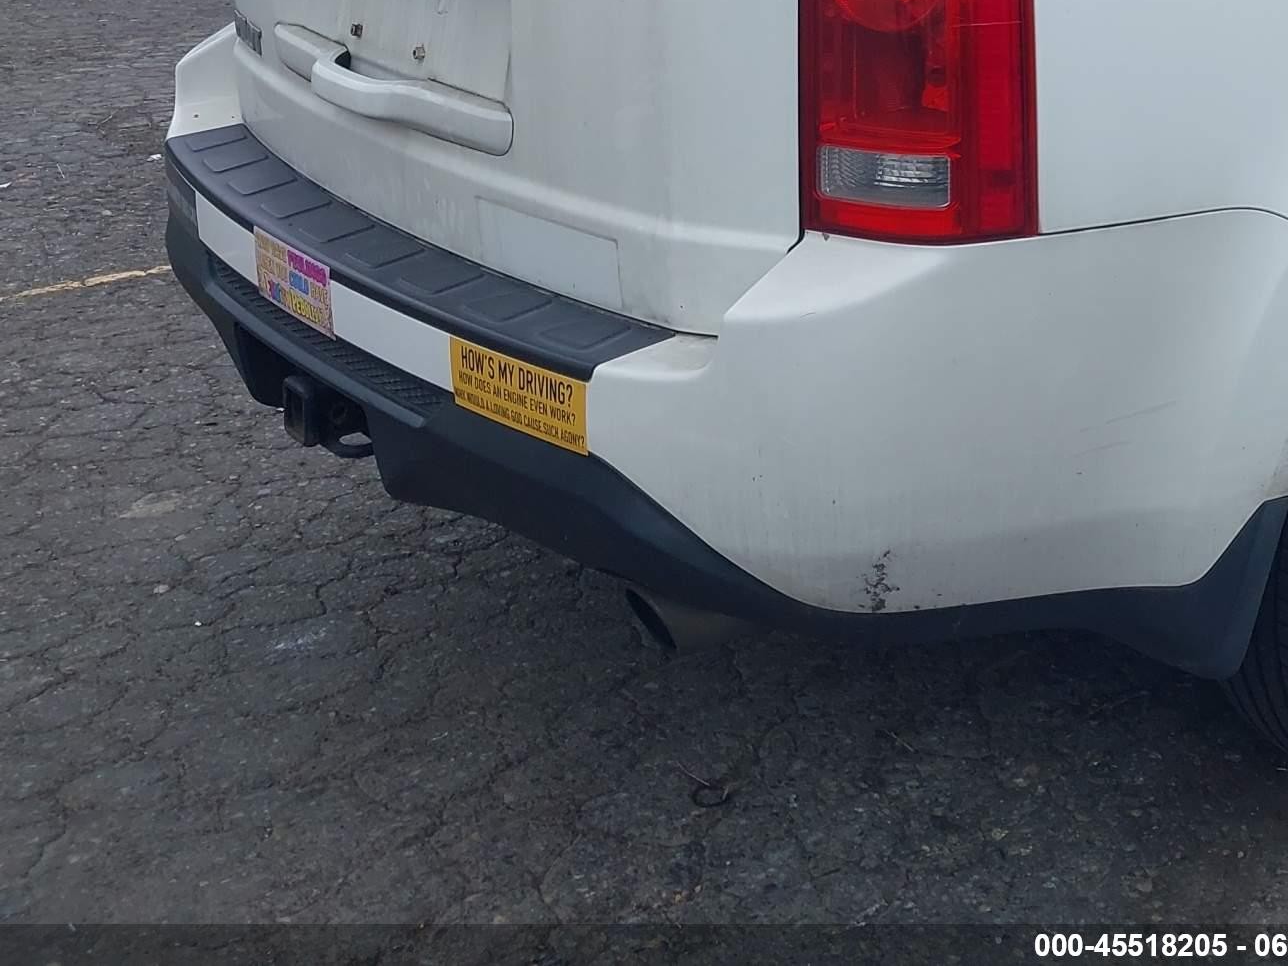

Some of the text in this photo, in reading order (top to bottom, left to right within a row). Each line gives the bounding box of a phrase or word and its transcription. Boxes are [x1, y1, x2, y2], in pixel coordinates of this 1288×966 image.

[458, 370, 473, 387] HOW
[474, 376, 491, 395] DOES
[493, 384, 502, 399] AN
[503, 388, 528, 410] ENGINE
[530, 397, 548, 416] EVEN
[549, 404, 576, 427] WORK?
[461, 345, 573, 408] HOW'S MY DRIVING?
[524, 414, 543, 433] CAUSE
[543, 421, 559, 439] SUCH
[560, 428, 585, 449] AGONY?
